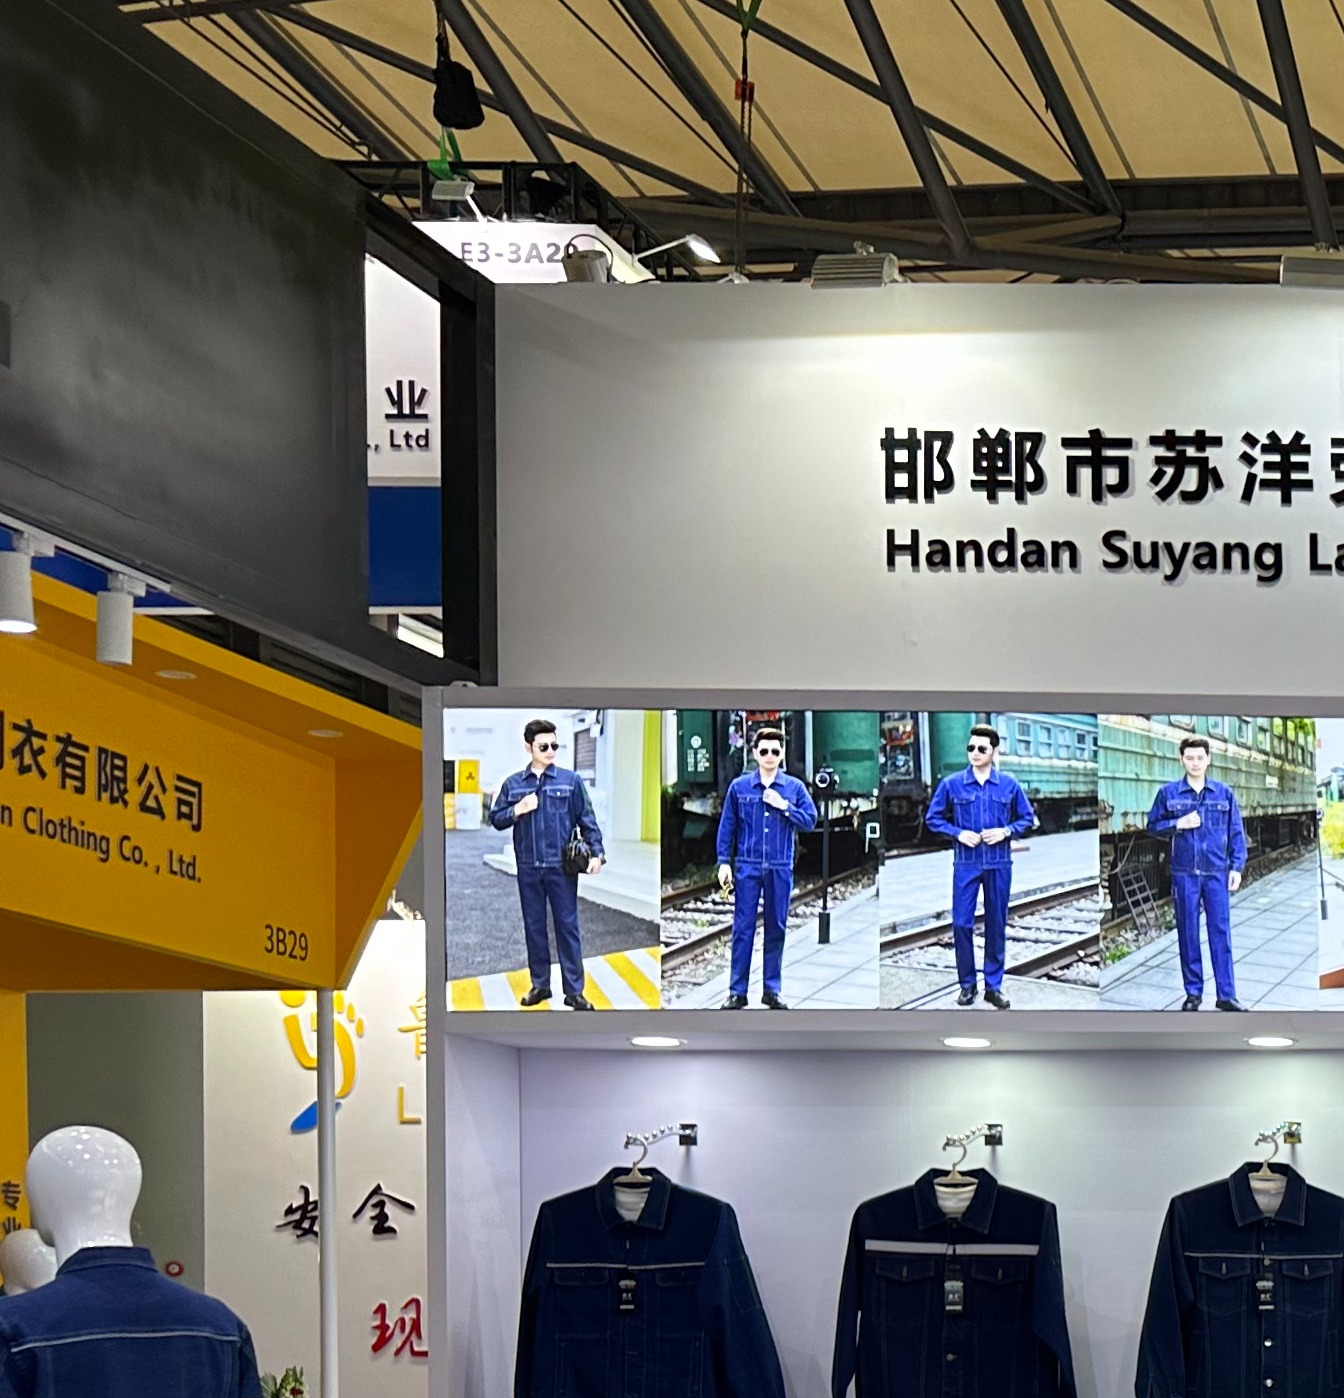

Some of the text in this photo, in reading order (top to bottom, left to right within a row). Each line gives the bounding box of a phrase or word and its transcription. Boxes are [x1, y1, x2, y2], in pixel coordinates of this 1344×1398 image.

[384, 380, 428, 420] 业
[886, 528, 1078, 574] Handan
[1101, 530, 1284, 583] Suyang
[0, 711, 203, 832] 衣有限公司
[23, 806, 111, 863] Clothing
[168, 849, 202, 883] Ltd.
[264, 924, 309, 961] 3B29
